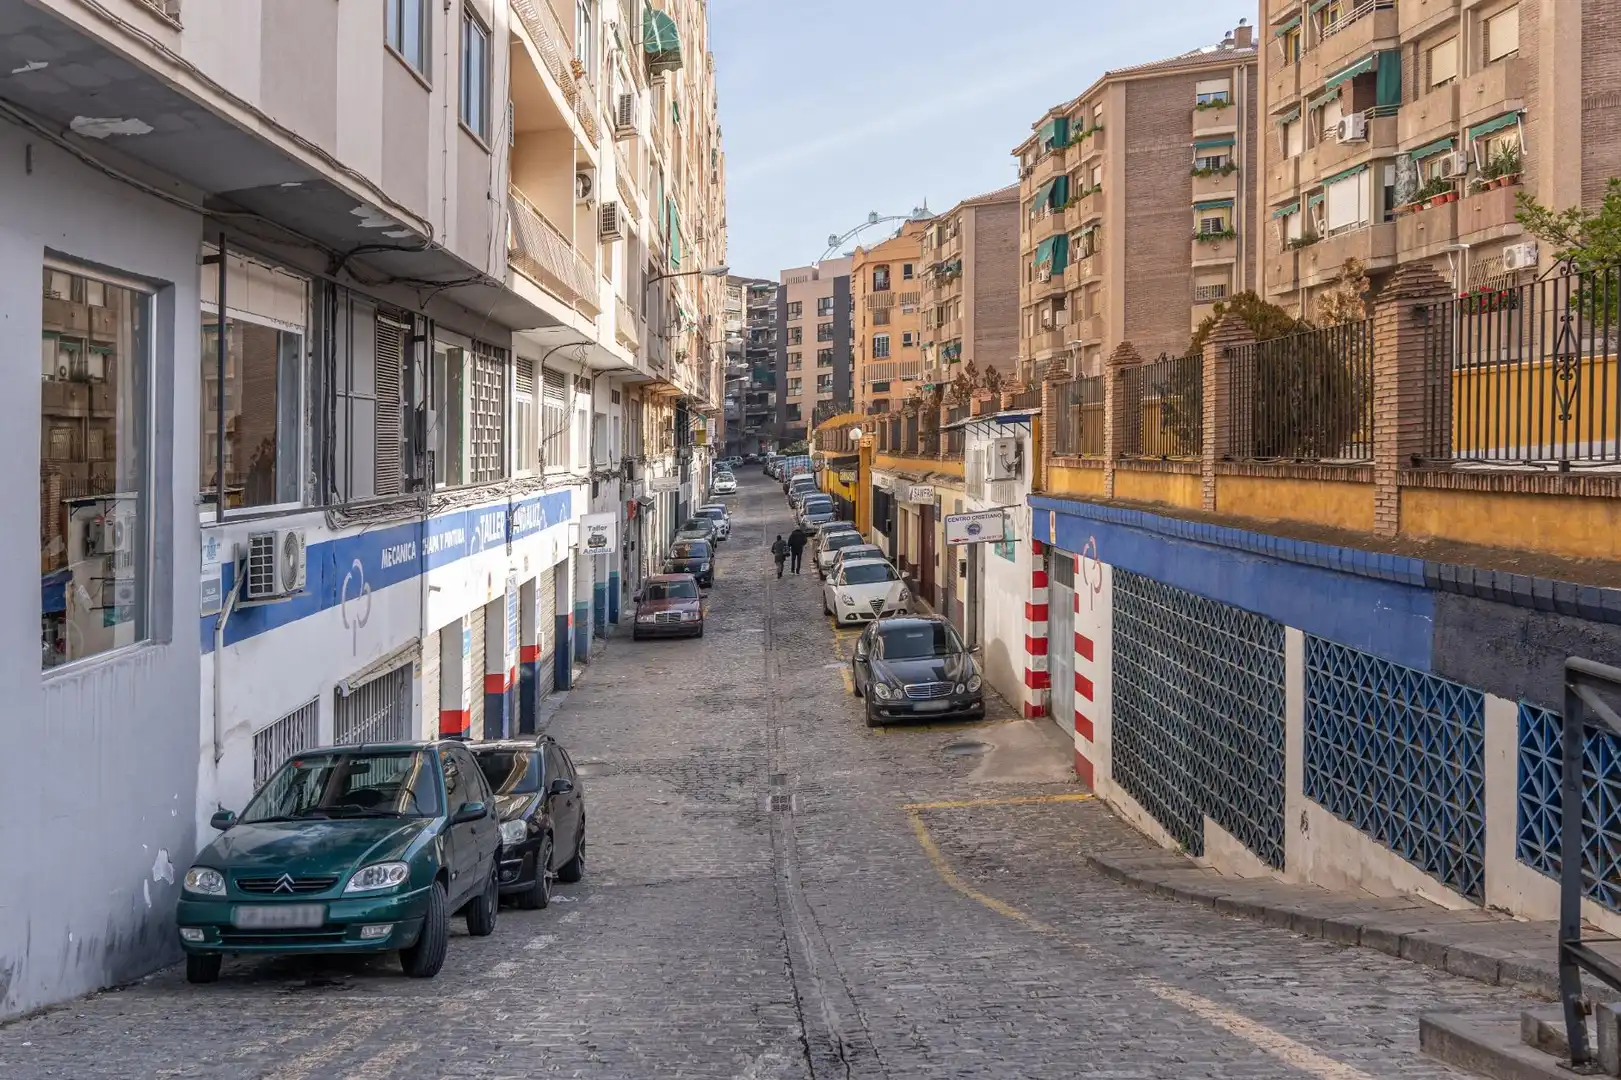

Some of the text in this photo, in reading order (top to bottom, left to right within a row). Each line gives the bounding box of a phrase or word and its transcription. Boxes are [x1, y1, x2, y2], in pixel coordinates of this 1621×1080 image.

[480, 503, 540, 543] TALLER ANDALUZ
[381, 541, 417, 570] MECANICA
[422, 535, 440, 556] CHAPA
[444, 528, 465, 549] PINTURA
[583, 547, 612, 555] Andaluz
